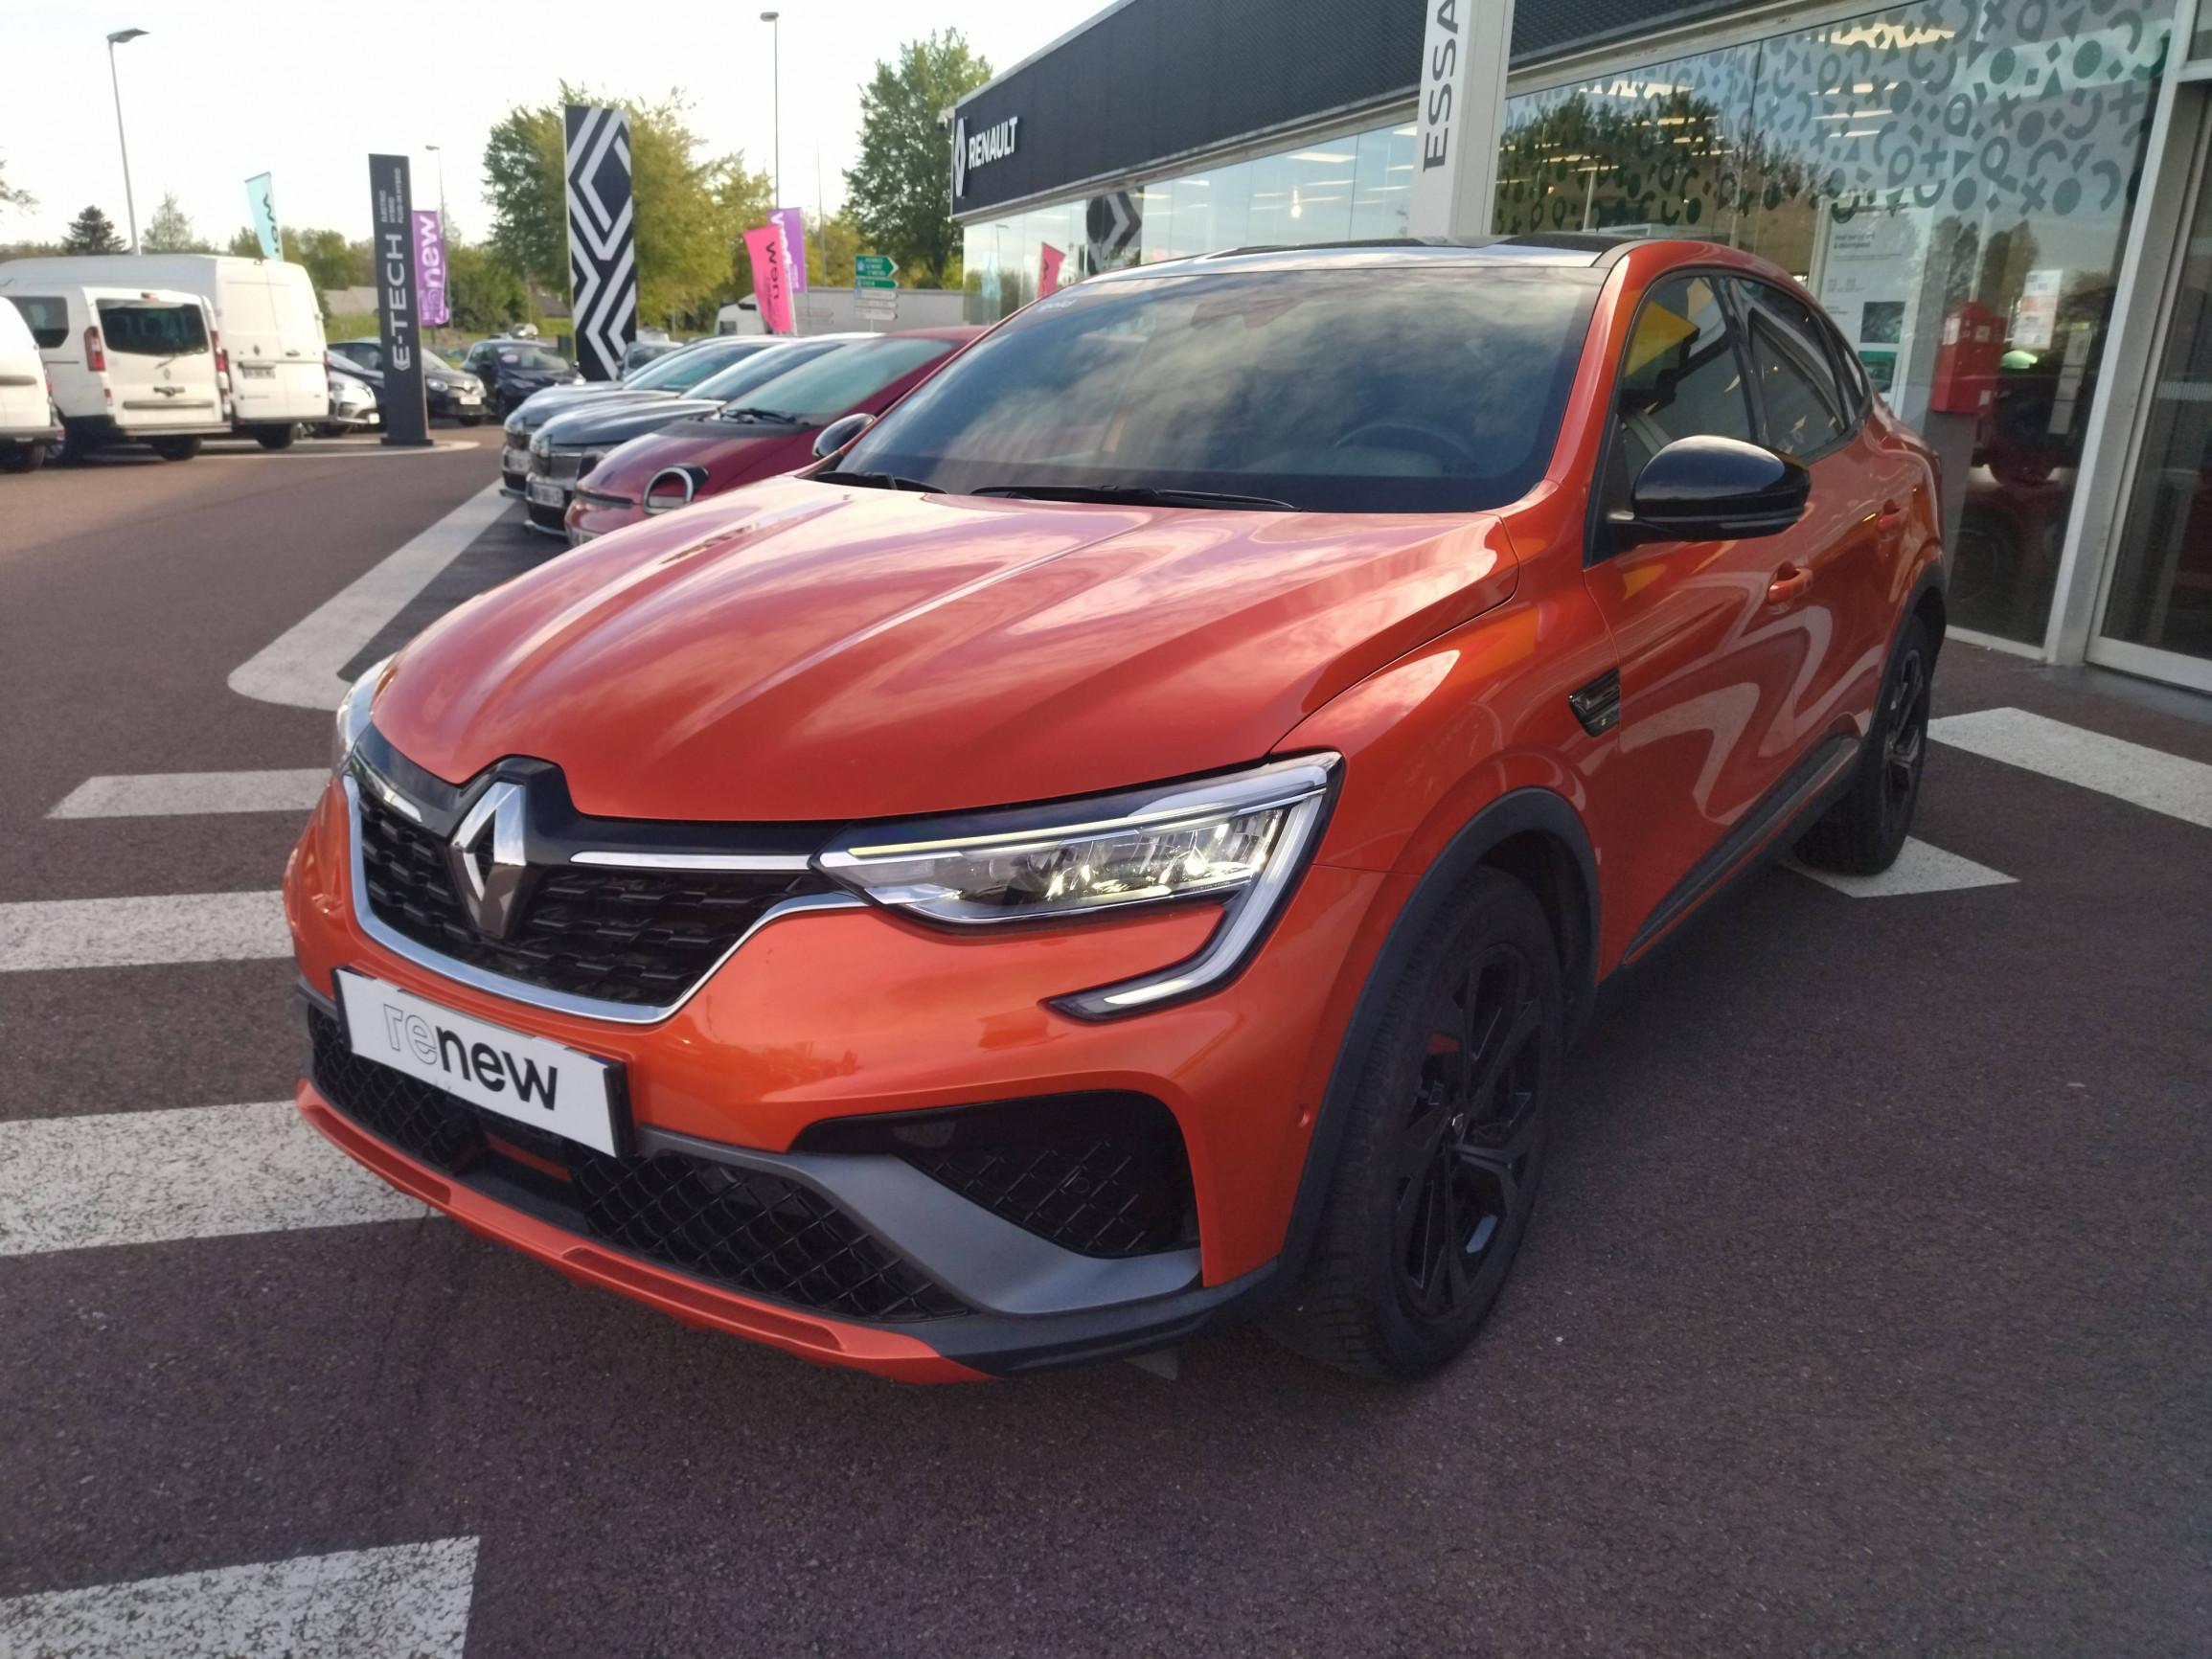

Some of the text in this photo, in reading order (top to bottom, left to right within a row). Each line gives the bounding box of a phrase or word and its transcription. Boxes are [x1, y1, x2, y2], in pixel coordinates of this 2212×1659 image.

[969, 116, 1018, 170] RENAULT
[1423, 0, 1459, 172] ESSA
[385, 234, 411, 372] E-TECH
[383, 1003, 558, 1112] renew
